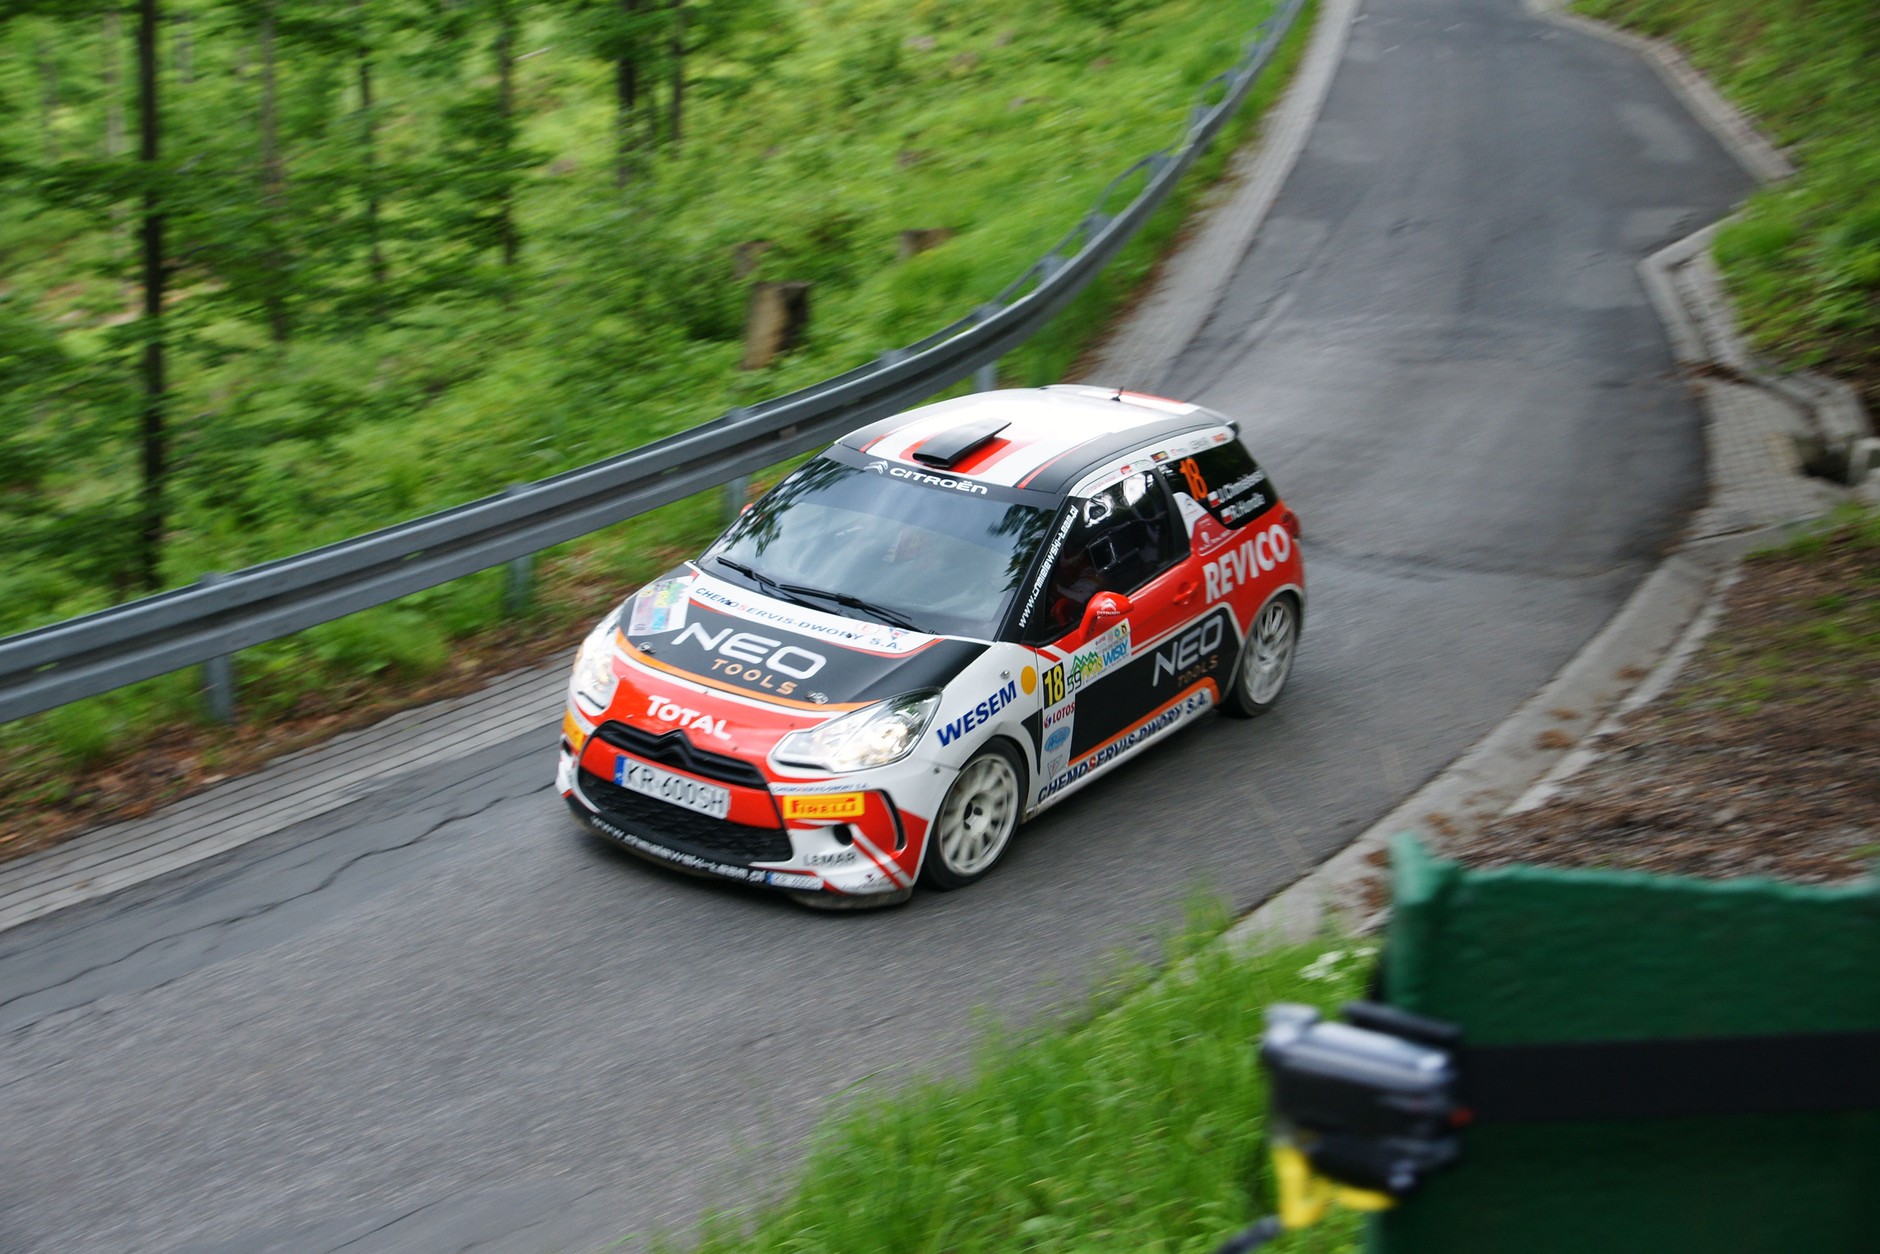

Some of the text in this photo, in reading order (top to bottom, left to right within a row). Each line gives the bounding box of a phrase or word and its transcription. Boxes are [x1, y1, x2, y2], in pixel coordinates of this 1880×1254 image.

[889, 467, 988, 495] CITROËN
[1180, 457, 1208, 500] 18
[1202, 525, 1291, 604] REVICO
[671, 622, 827, 680] NEO
[1152, 614, 1224, 688] NEO
[711, 658, 798, 696] TOOLS
[1044, 664, 1065, 707] 18
[1066, 669, 1083, 695] 59
[647, 694, 733, 741] TOTAL
[936, 680, 1017, 748] WESEM
[1052, 701, 1076, 724] LOTOS
[626, 762, 654, 793] KR
[790, 797, 858, 814] PIRELLI
[802, 851, 858, 867] LEMAR
